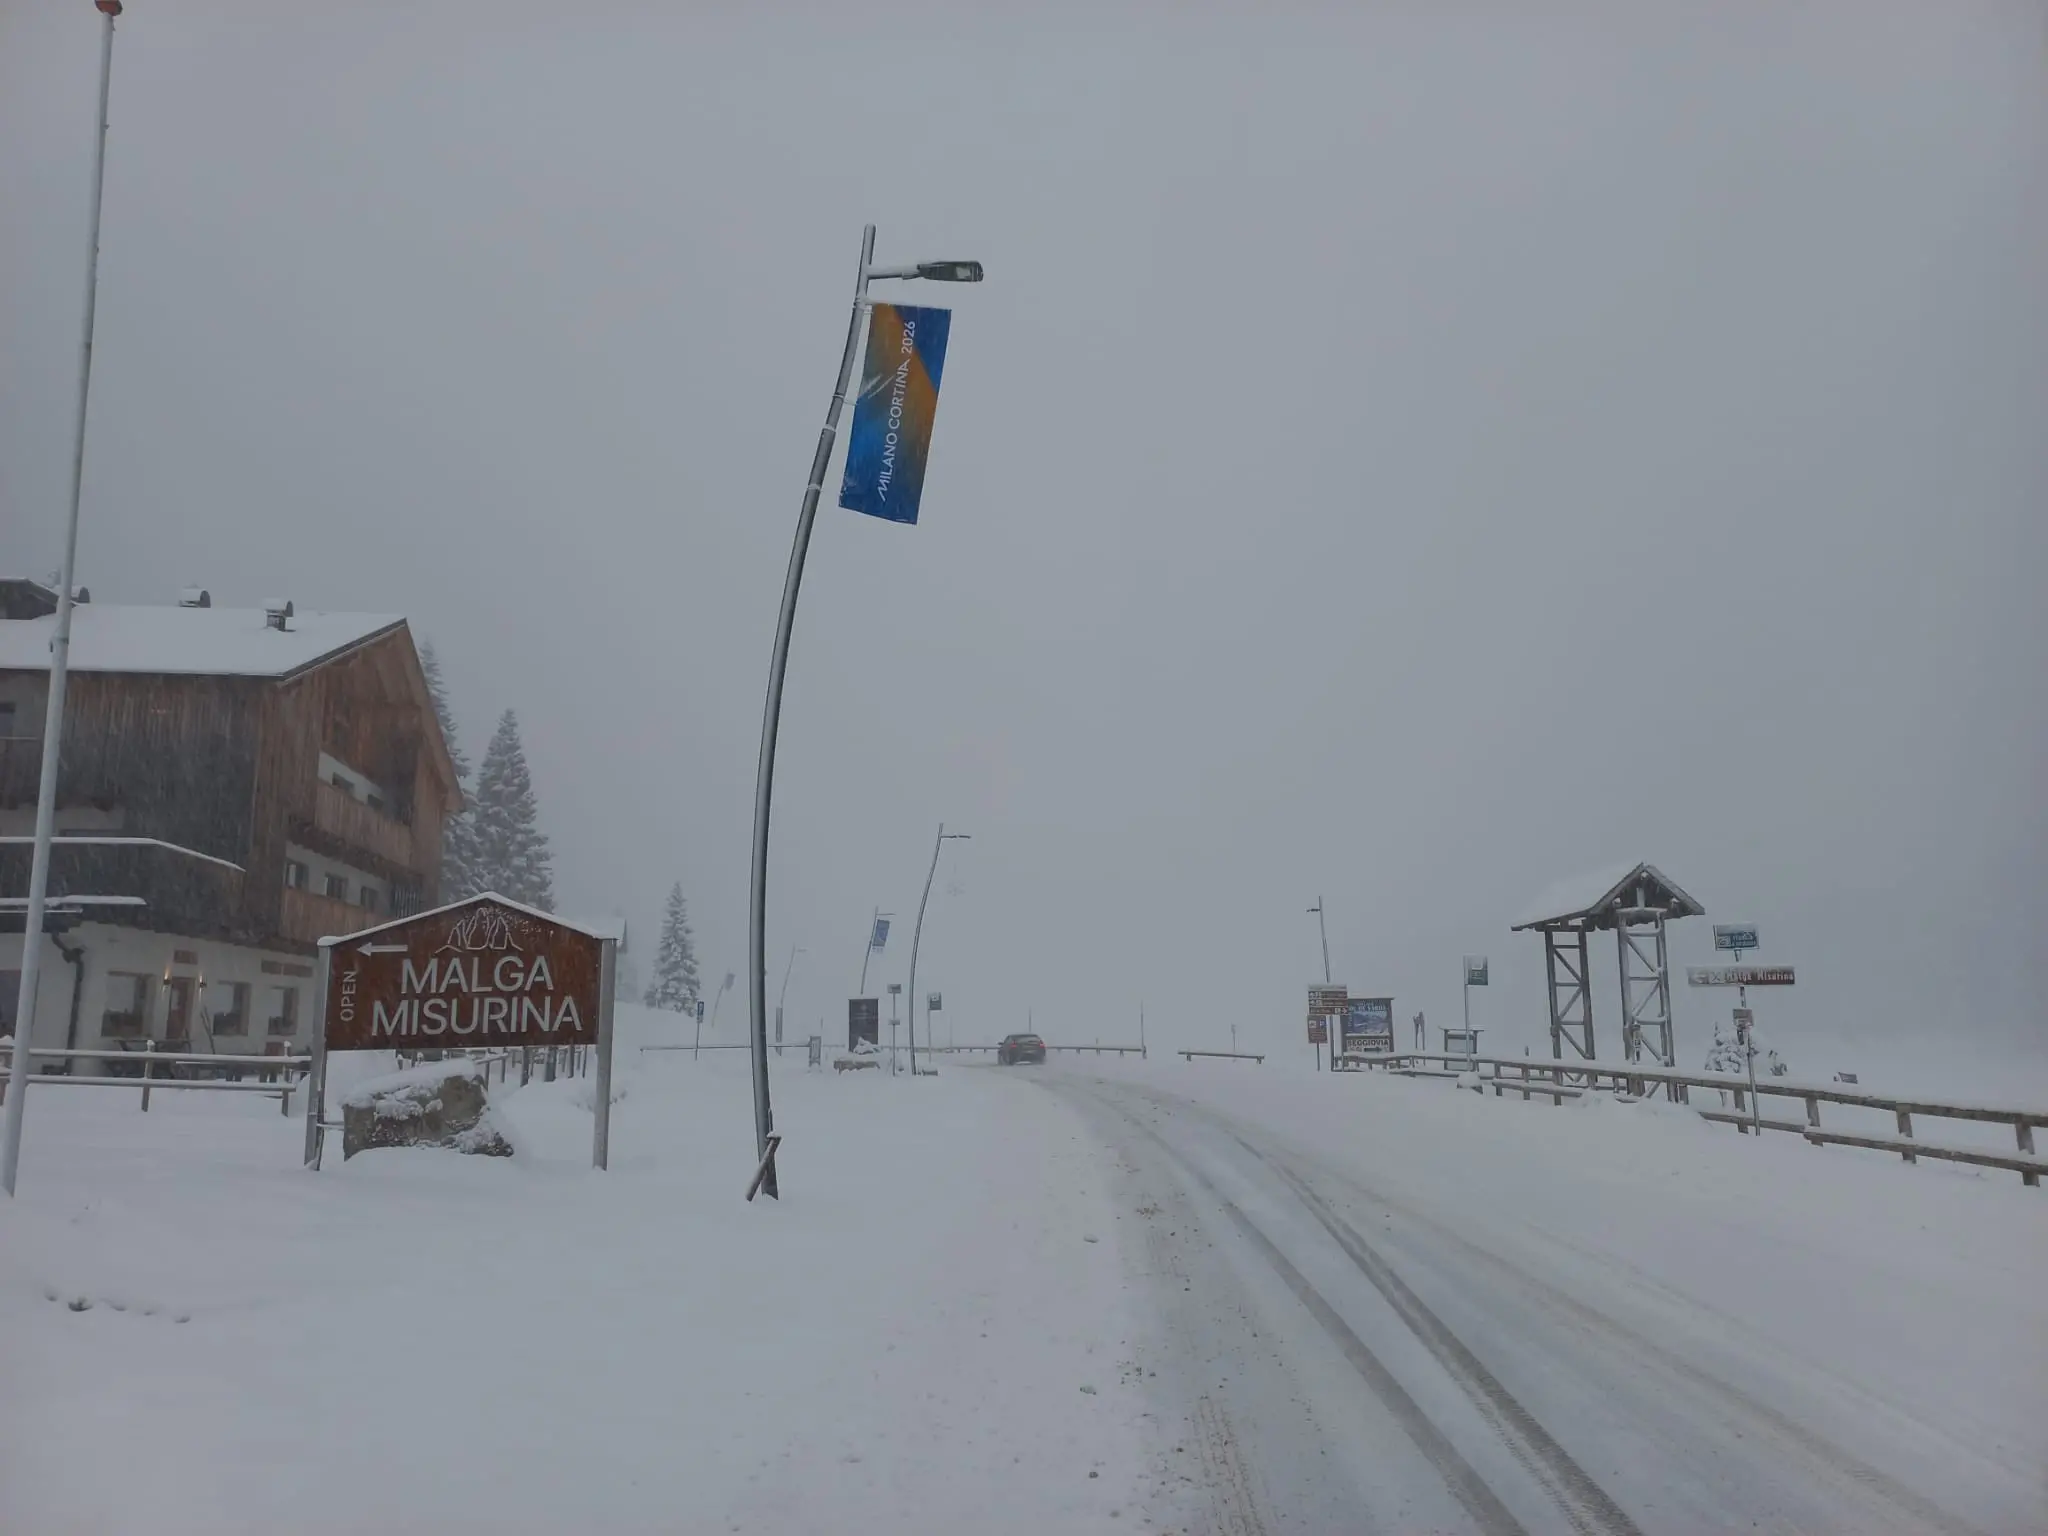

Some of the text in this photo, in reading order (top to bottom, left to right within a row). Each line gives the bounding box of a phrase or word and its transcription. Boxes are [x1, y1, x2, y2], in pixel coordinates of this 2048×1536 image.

[876, 320, 916, 502] MILANO CORTINA 2026
[340, 970, 356, 1022] OPEN
[401, 955, 554, 994] MALGA
[371, 996, 582, 1036] MISURINA
